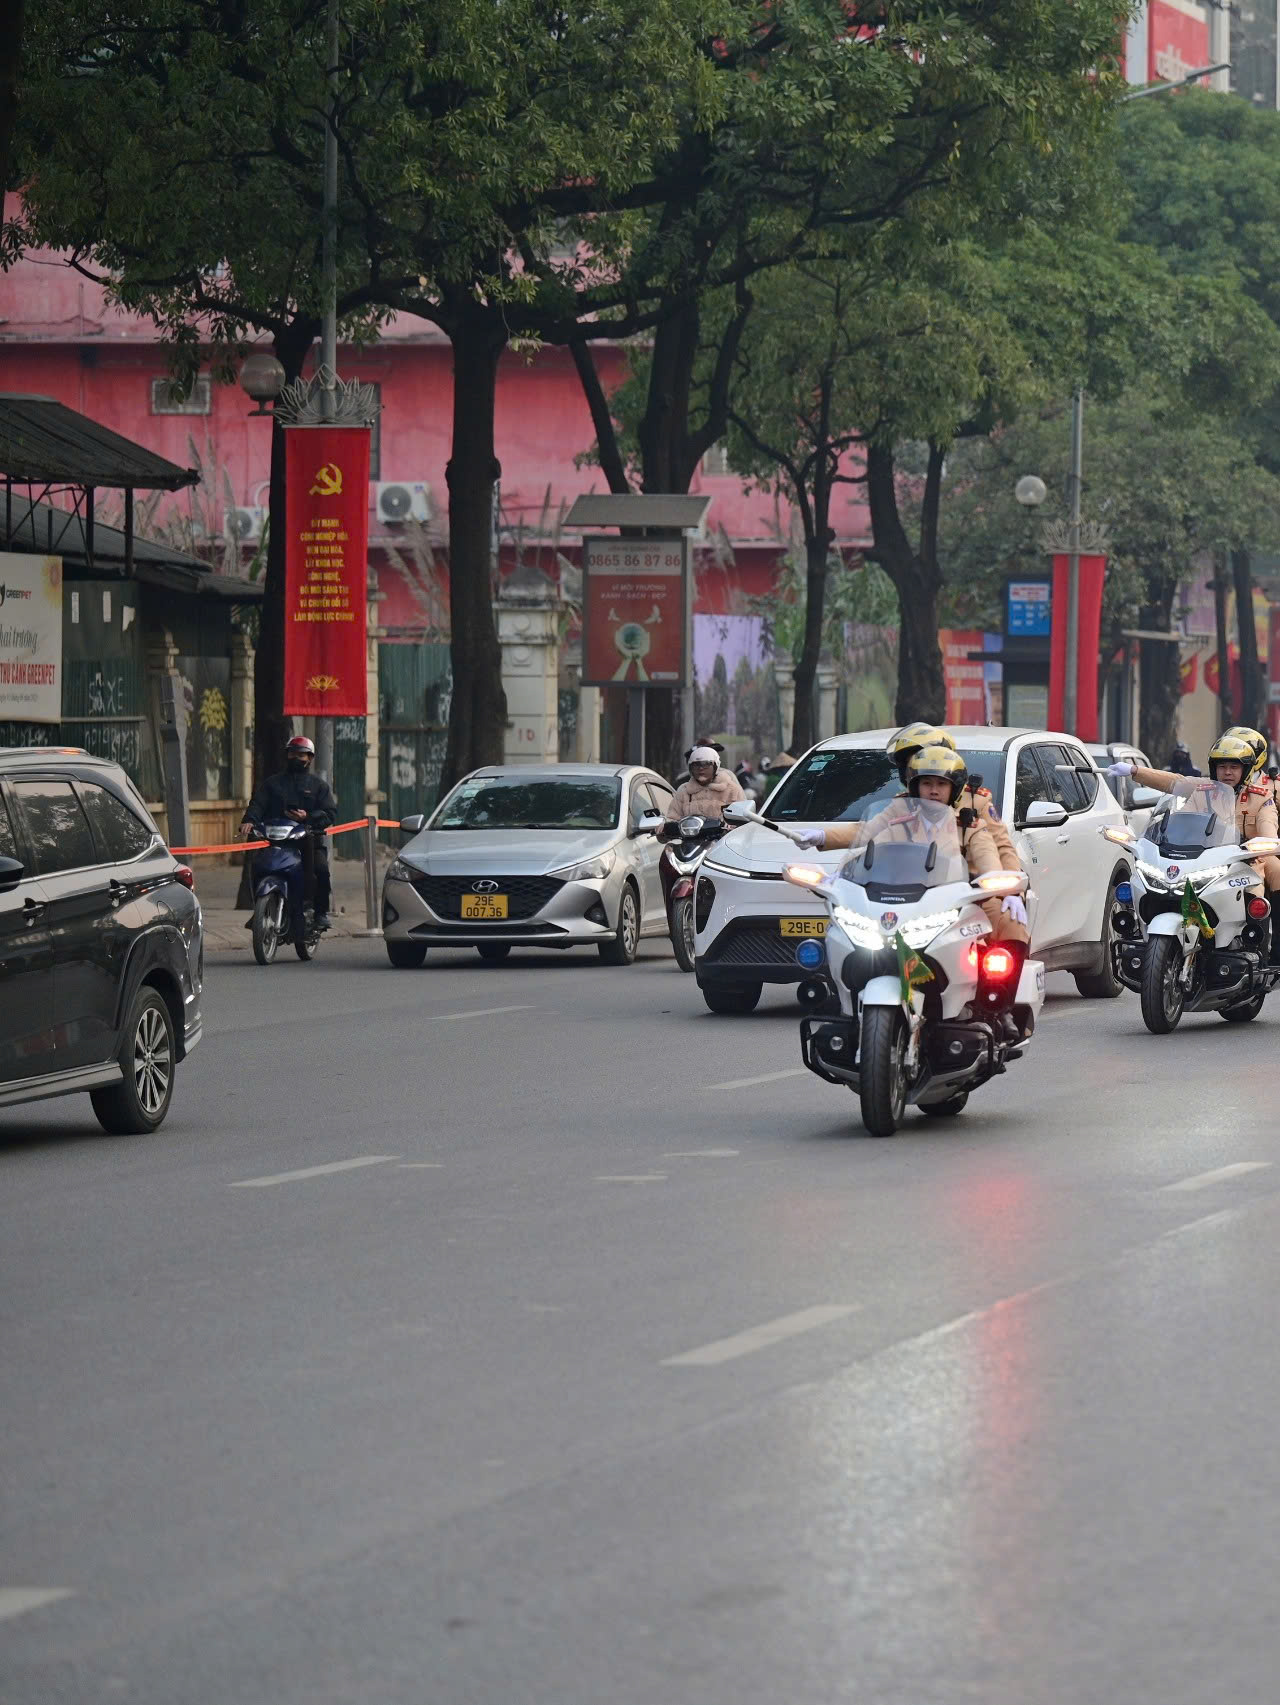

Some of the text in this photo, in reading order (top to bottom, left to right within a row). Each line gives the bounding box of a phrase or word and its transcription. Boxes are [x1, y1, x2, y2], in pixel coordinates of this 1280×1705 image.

[588, 554, 681, 567] 0865 86 87 86
[308, 571, 322, 581] ÔN
[6, 589, 32, 600] GREENPET
[1228, 876, 1251, 888] CSGT
[474, 896, 494, 906] 29E
[466, 907, 502, 918] 007.36
[959, 924, 983, 937] CSGT
